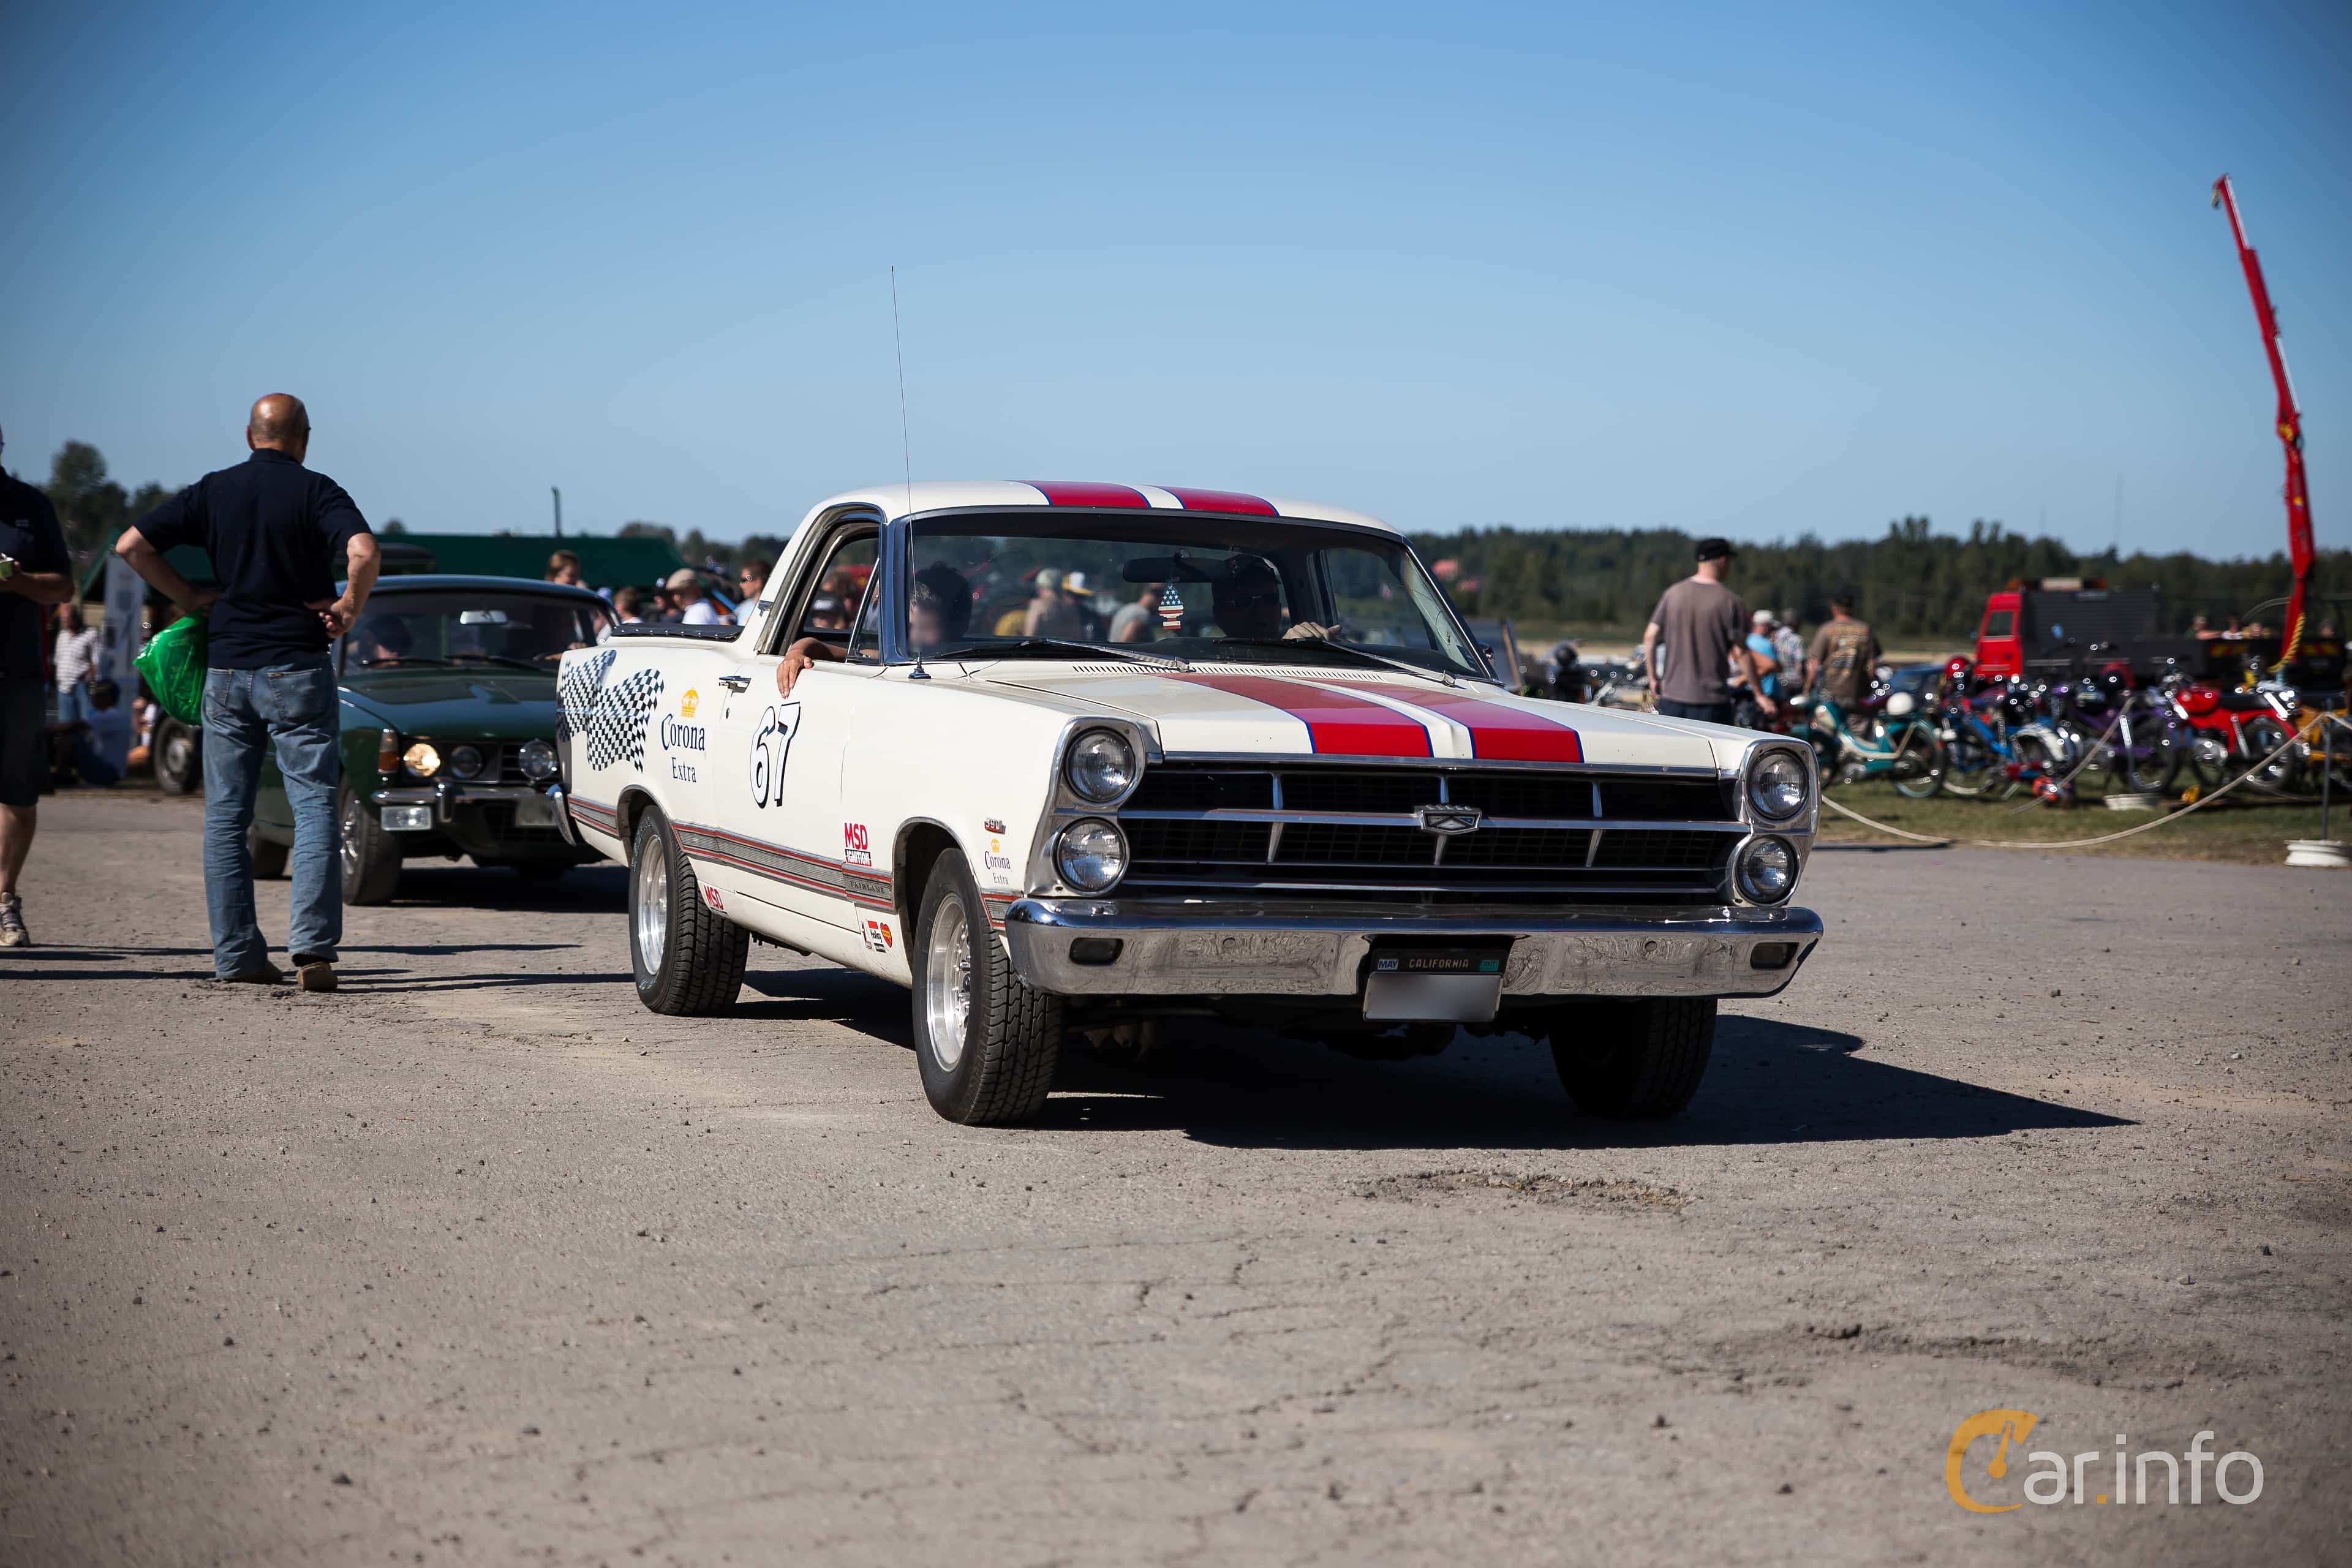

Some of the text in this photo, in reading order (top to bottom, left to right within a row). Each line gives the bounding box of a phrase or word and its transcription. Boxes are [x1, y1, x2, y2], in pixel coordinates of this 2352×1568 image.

[662, 714, 705, 751] Corona
[750, 701, 801, 809] 67
[671, 756, 696, 783] Extra
[845, 823, 868, 850] MSD
[846, 850, 871, 865] IGNITION
[984, 851, 1011, 870] Corona
[850, 881, 885, 894] FAIRLANE
[993, 873, 1009, 885] Extra
[704, 885, 724, 910] MSD
[1379, 960, 1398, 968] MAY
[1409, 959, 1469, 968] CALIFORNIA
